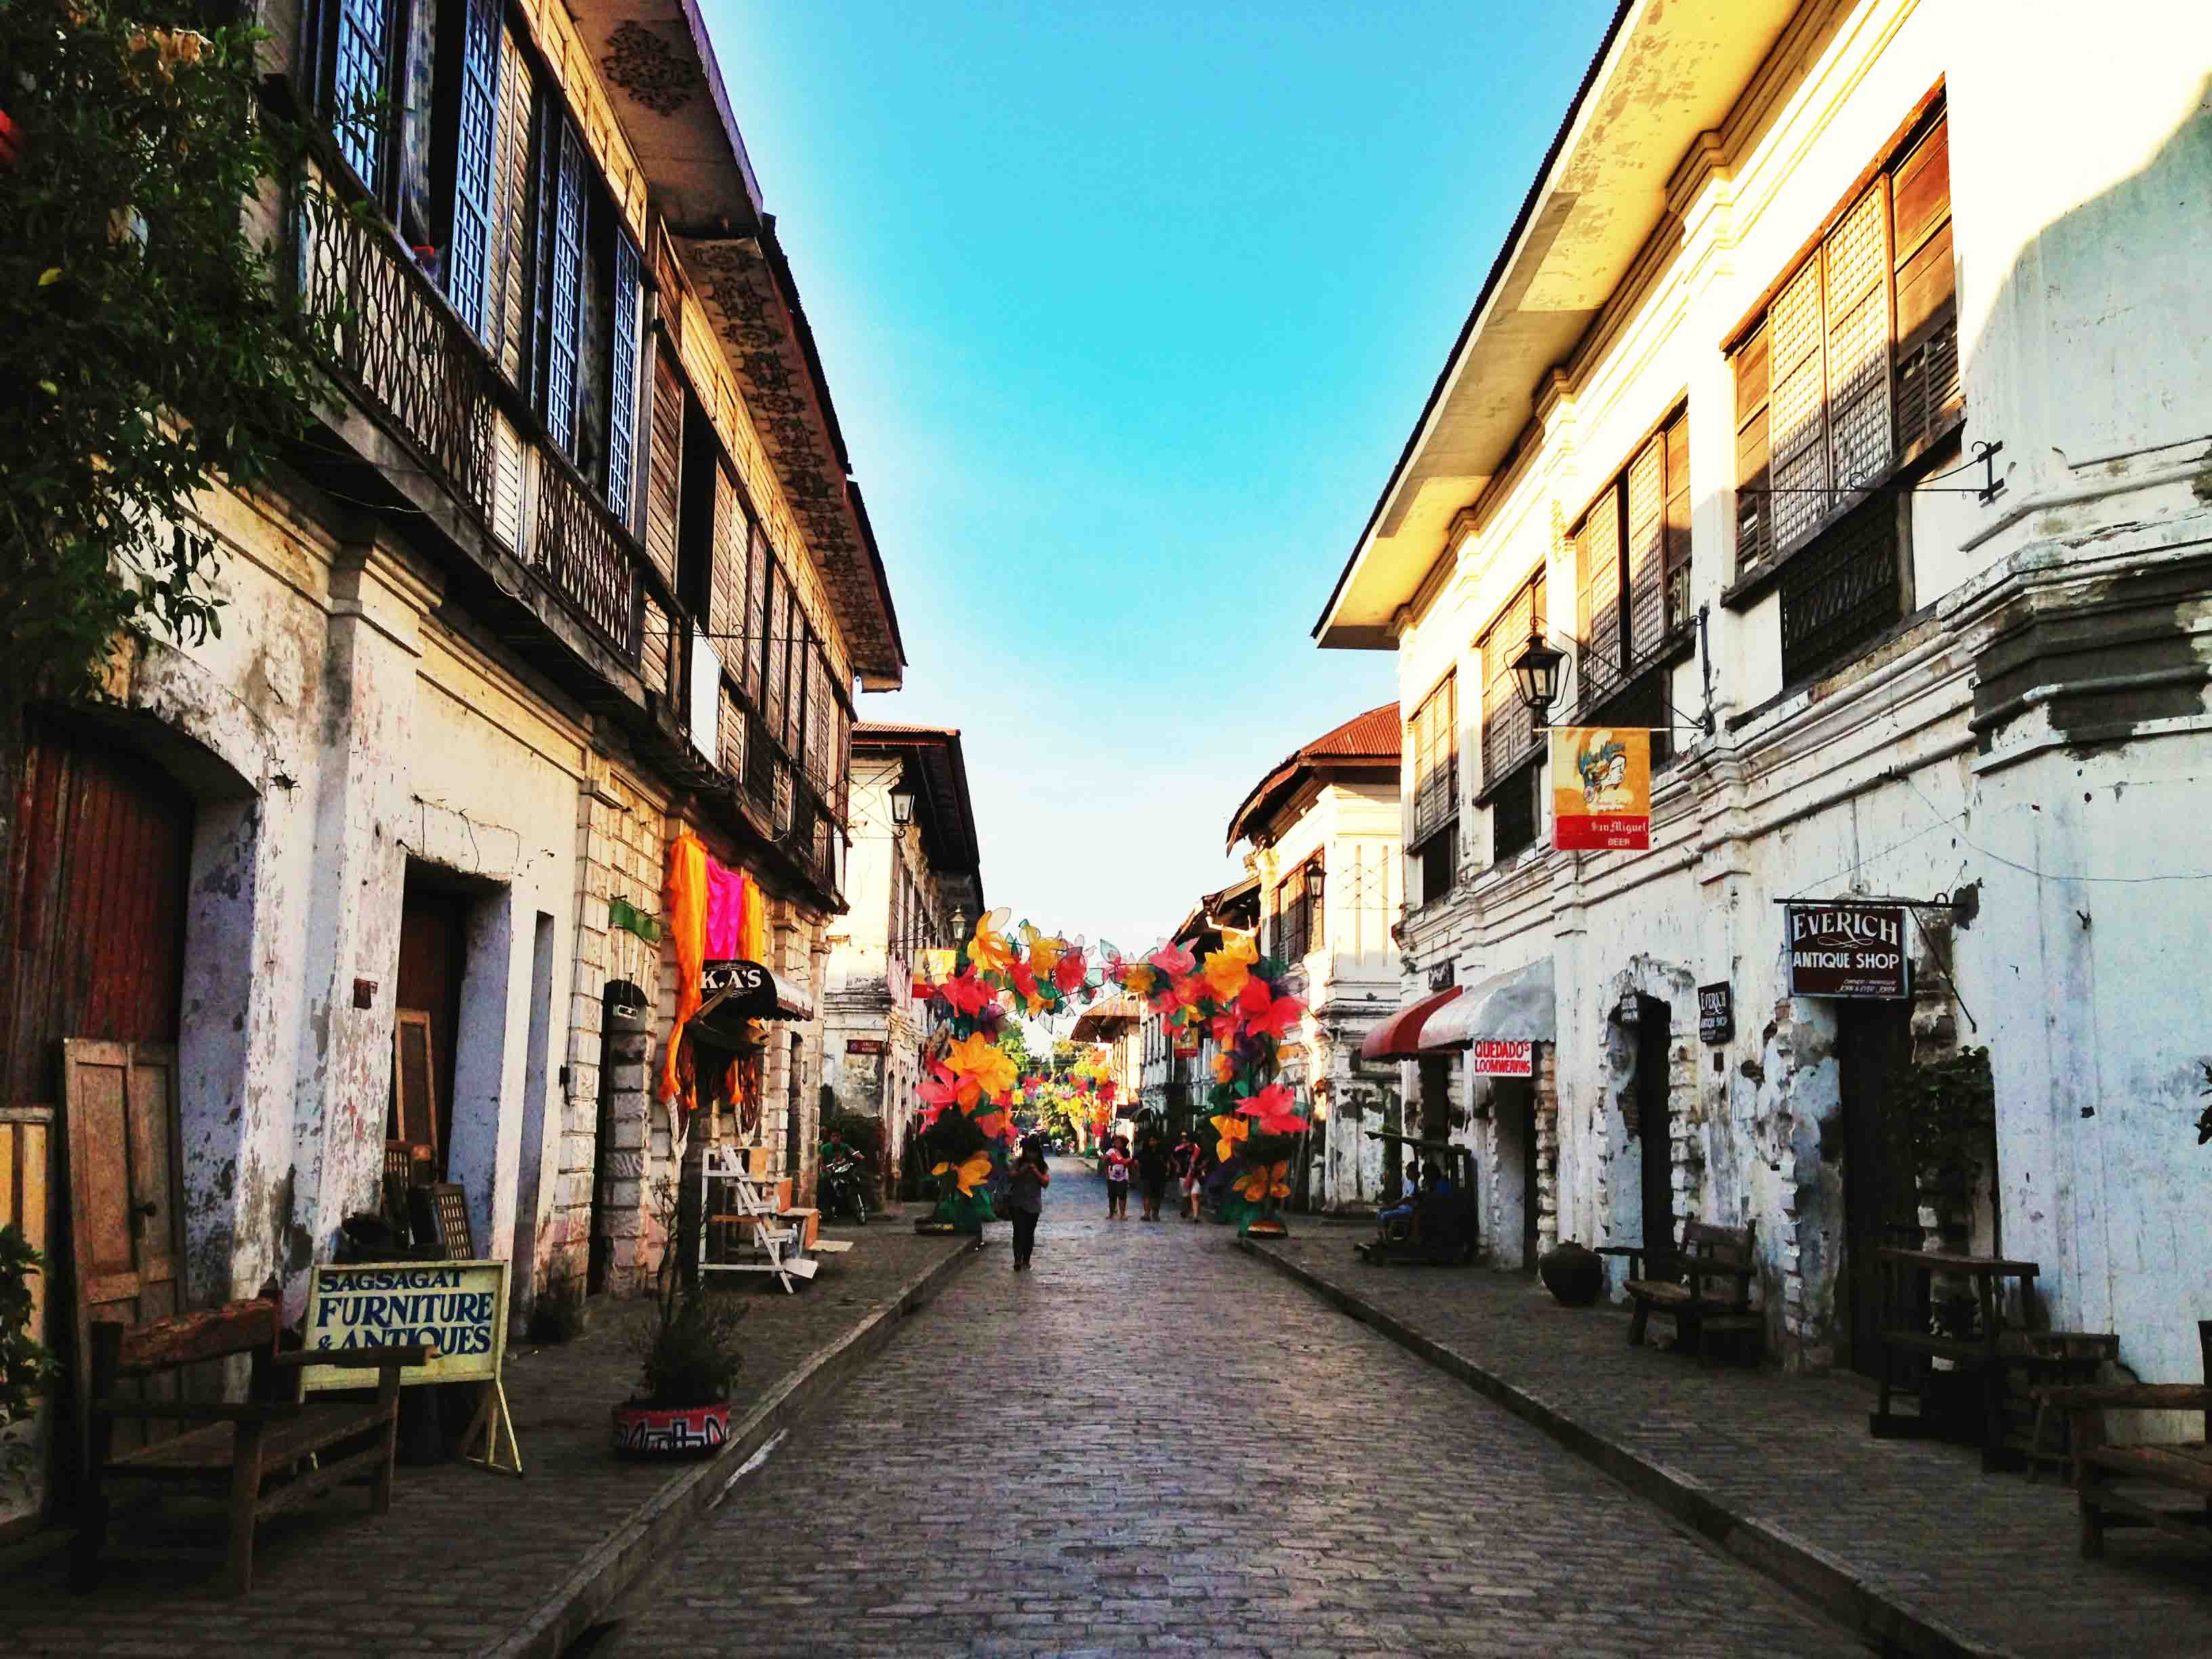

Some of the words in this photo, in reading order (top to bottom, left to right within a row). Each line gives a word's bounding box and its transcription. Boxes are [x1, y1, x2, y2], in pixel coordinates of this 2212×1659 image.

[1607, 837, 1630, 846] BEER
[1793, 912, 1898, 946] EVERICH
[1793, 951, 1850, 968] ANTIQUE
[1856, 953, 1900, 969] SHOP
[319, 1269, 464, 1293] SAGSAGAT
[316, 1292, 495, 1327] FURNITURE
[341, 1326, 491, 1359] ANTIQUES
